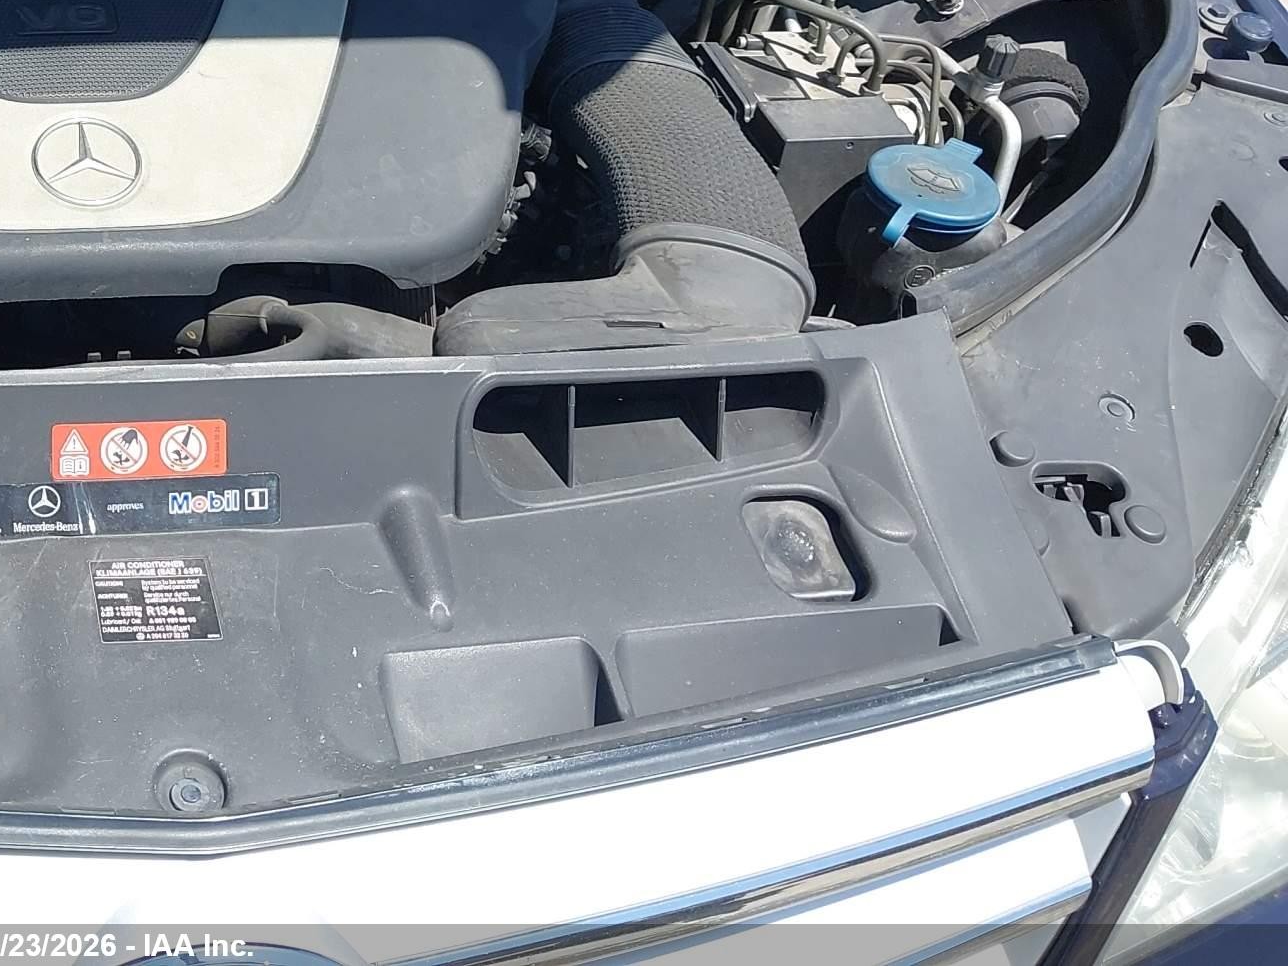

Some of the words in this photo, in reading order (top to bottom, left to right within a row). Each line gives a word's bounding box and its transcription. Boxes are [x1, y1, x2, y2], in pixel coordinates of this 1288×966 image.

[106, 502, 144, 513] approves
[168, 489, 240, 515] Mobil
[13, 521, 79, 533] Mercedes-Benz
[112, 561, 126, 570] AIR
[127, 560, 184, 569] CONDITIONER
[95, 568, 156, 577] KLIMAANLAGE
[145, 605, 186, 617] R134a
